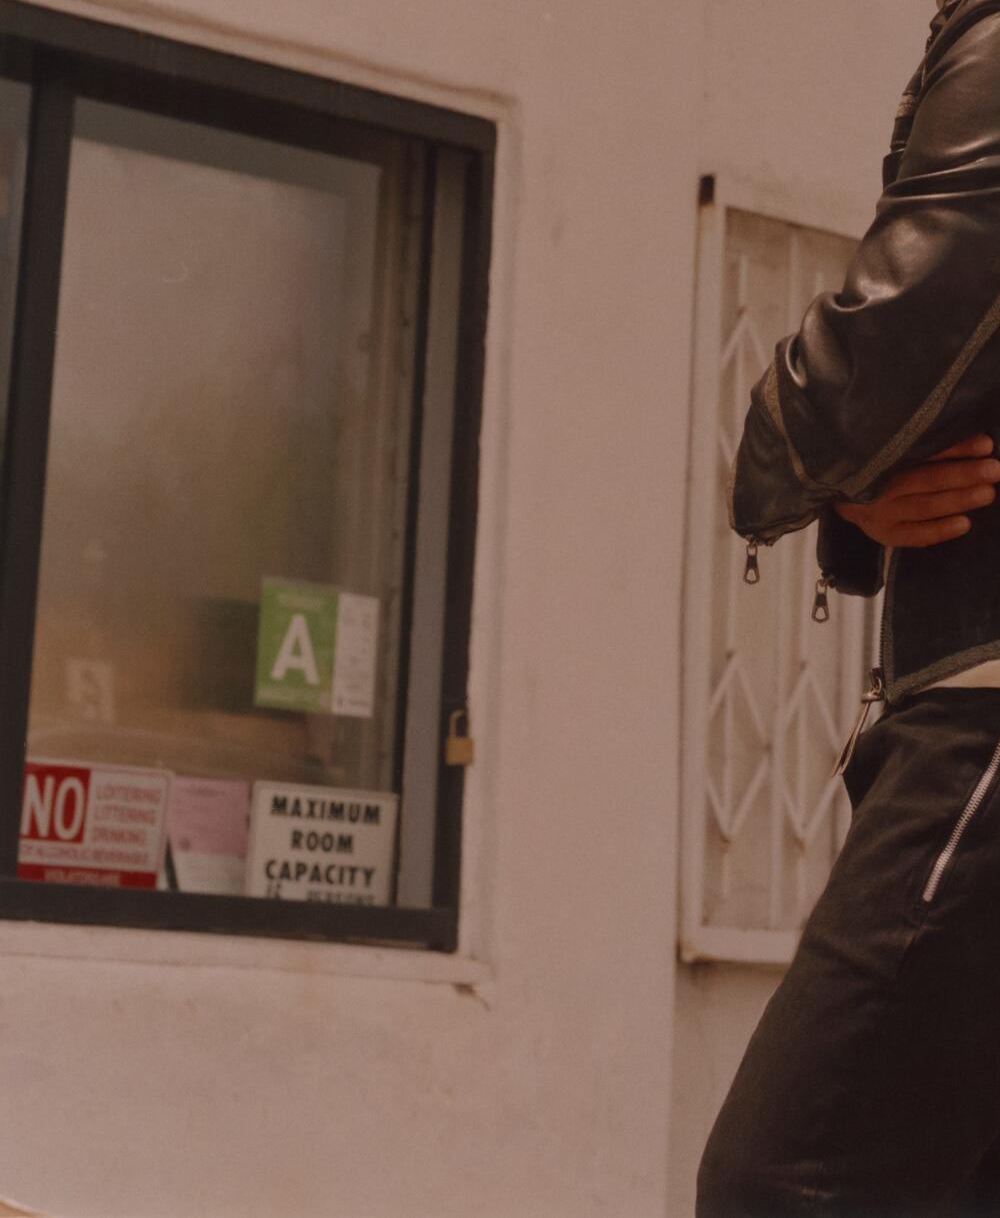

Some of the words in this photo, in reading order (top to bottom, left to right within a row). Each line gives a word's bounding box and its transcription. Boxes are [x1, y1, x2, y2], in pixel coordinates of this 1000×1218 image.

[271, 614, 319, 685] A
[20, 773, 85, 841] NO
[270, 795, 380, 825] MAXIMUM
[291, 830, 353, 854] ROOM
[265, 858, 376, 887] CAPACITY
